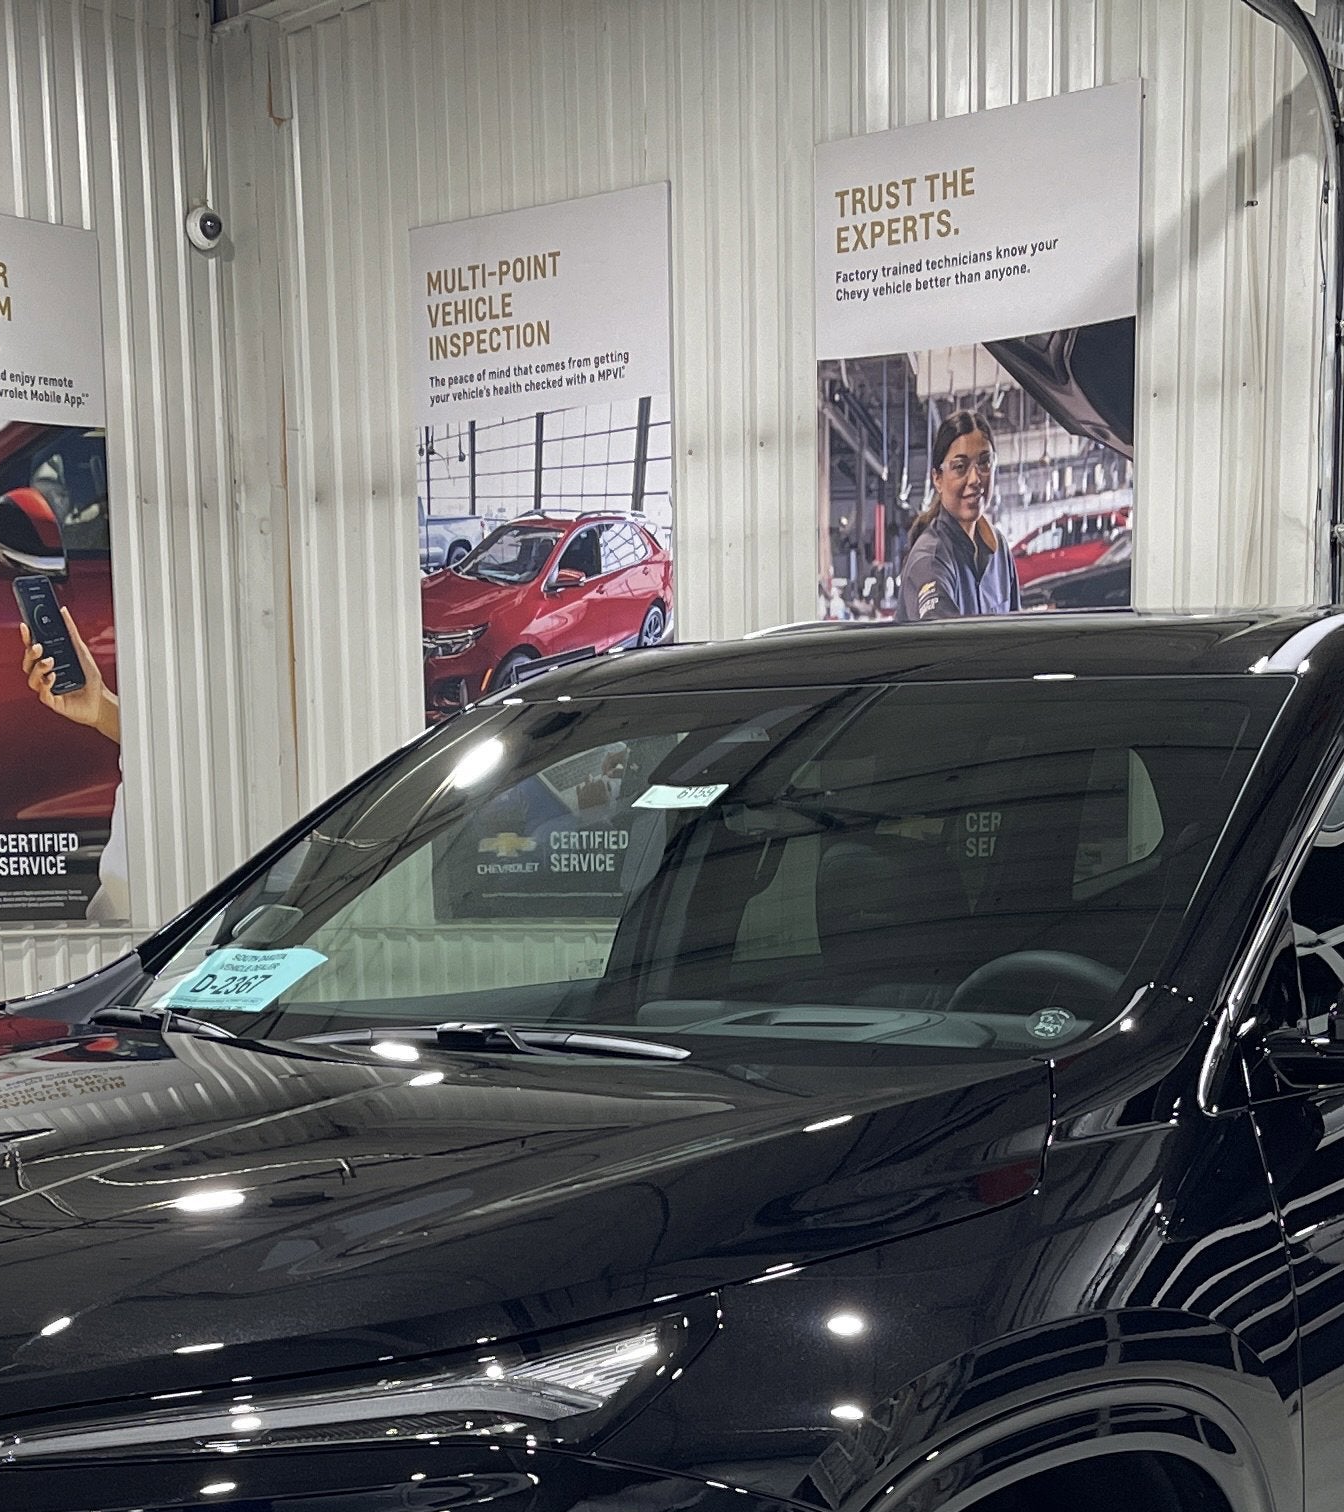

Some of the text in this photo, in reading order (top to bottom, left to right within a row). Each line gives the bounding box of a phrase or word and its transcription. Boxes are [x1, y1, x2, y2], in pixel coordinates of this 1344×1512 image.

[835, 167, 975, 218] TRUST THE
[836, 209, 960, 254] EXPERTS.
[427, 251, 561, 296] MULTI-POINT
[836, 238, 1059, 285] Factory trained technicians know your
[836, 264, 1031, 302] Chevy vehicle better than anyone.
[427, 293, 513, 328] VEHICLE
[429, 320, 550, 361] INSPECTION
[9, 370, 36, 388] enjoy
[38, 375, 73, 388] remote
[429, 351, 629, 388] The peace of mind that comes from getting
[30, 389, 61, 404] Mobile
[430, 391, 450, 407] your
[452, 385, 491, 402] vehicle's
[493, 381, 522, 397] health
[524, 377, 563, 393] checked
[565, 372, 587, 387] with
[589, 372, 595, 382] a
[550, 830, 629, 850] CERTIFIED
[477, 862, 539, 874] CHEVROLET
[550, 853, 615, 872] SERVICE
[190, 974, 273, 995] D-2367
